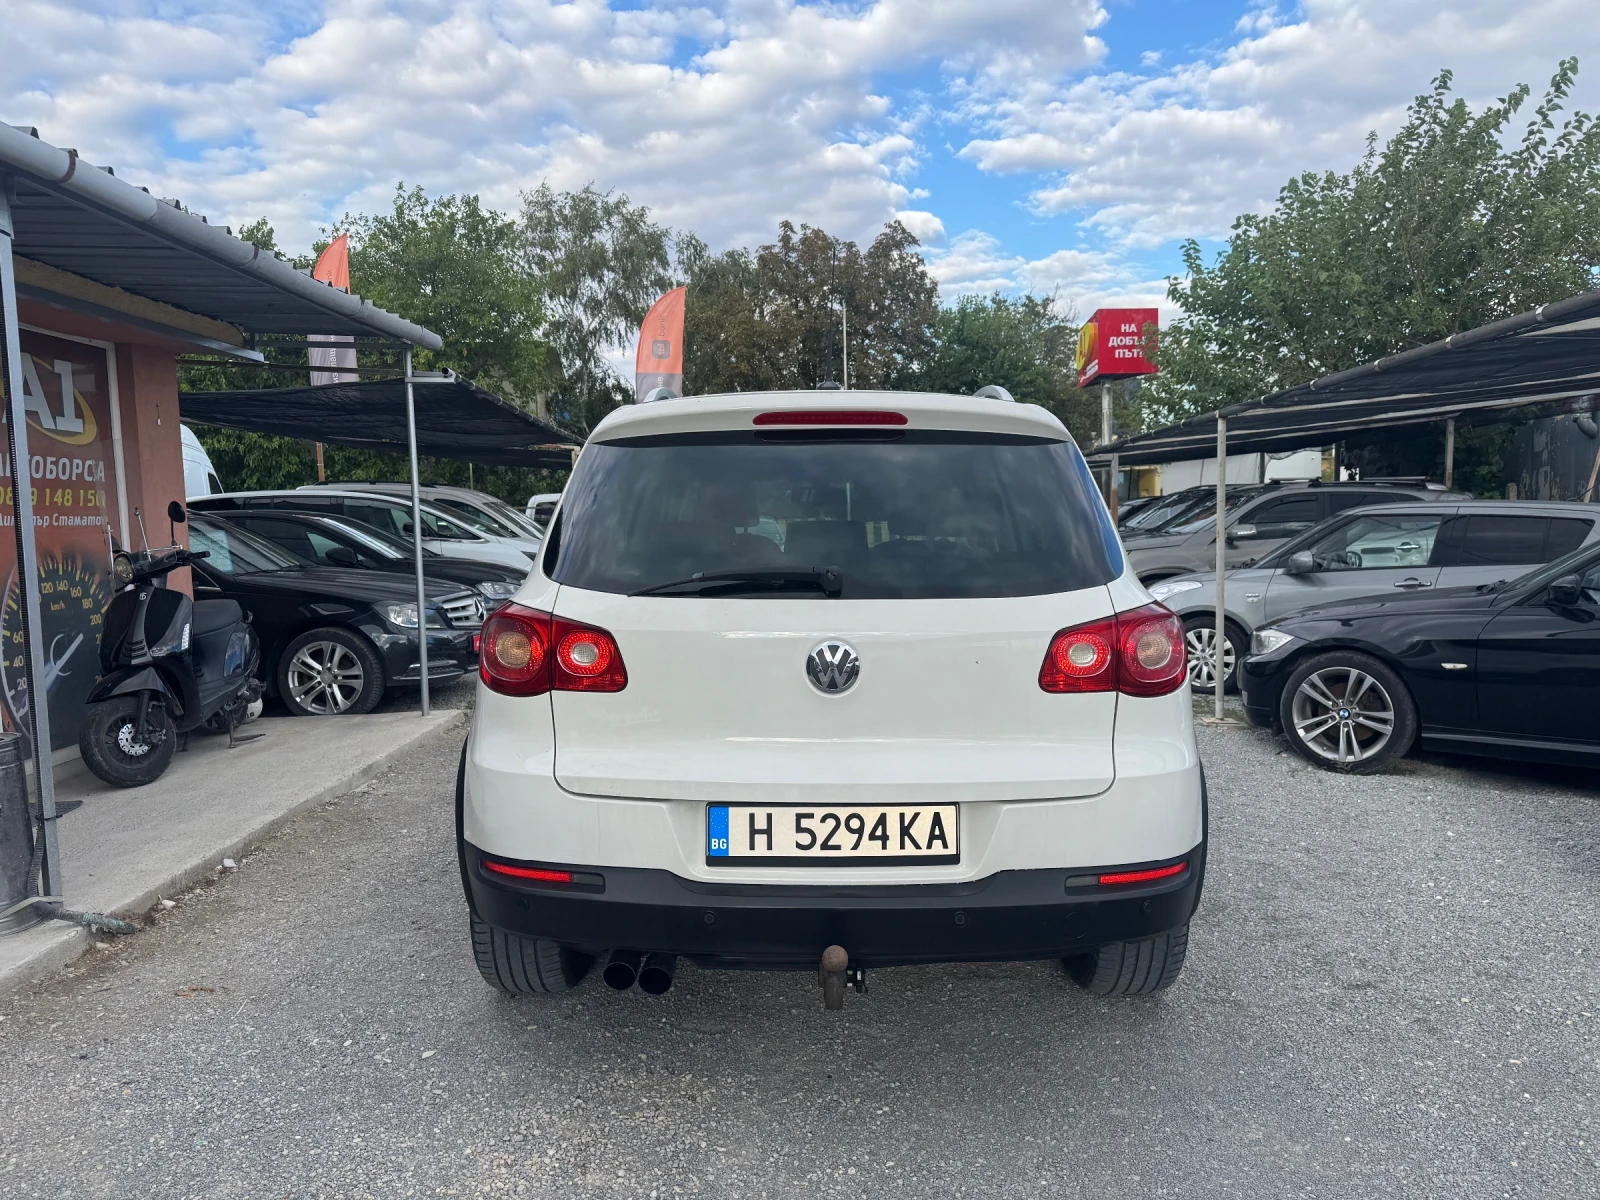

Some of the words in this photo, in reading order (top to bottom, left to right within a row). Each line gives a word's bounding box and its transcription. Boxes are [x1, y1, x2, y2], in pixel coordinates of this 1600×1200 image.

[1121, 324, 1137, 333] НА
[45, 488, 73, 507] 148
[41, 582, 53, 594] 120
[56, 580, 68, 591] 140
[70, 587, 82, 598] 160
[50, 600, 65, 611] km/h
[82, 598, 93, 609] 180
[90, 613, 102, 625] 200
[13, 631, 24, 643] 60
[13, 655, 24, 668] 40
[17, 677, 28, 690] 20
[749, 812, 773, 851] H
[795, 812, 890, 851] 5294
[899, 811, 949, 850] KA
[711, 838, 727, 850] BG
